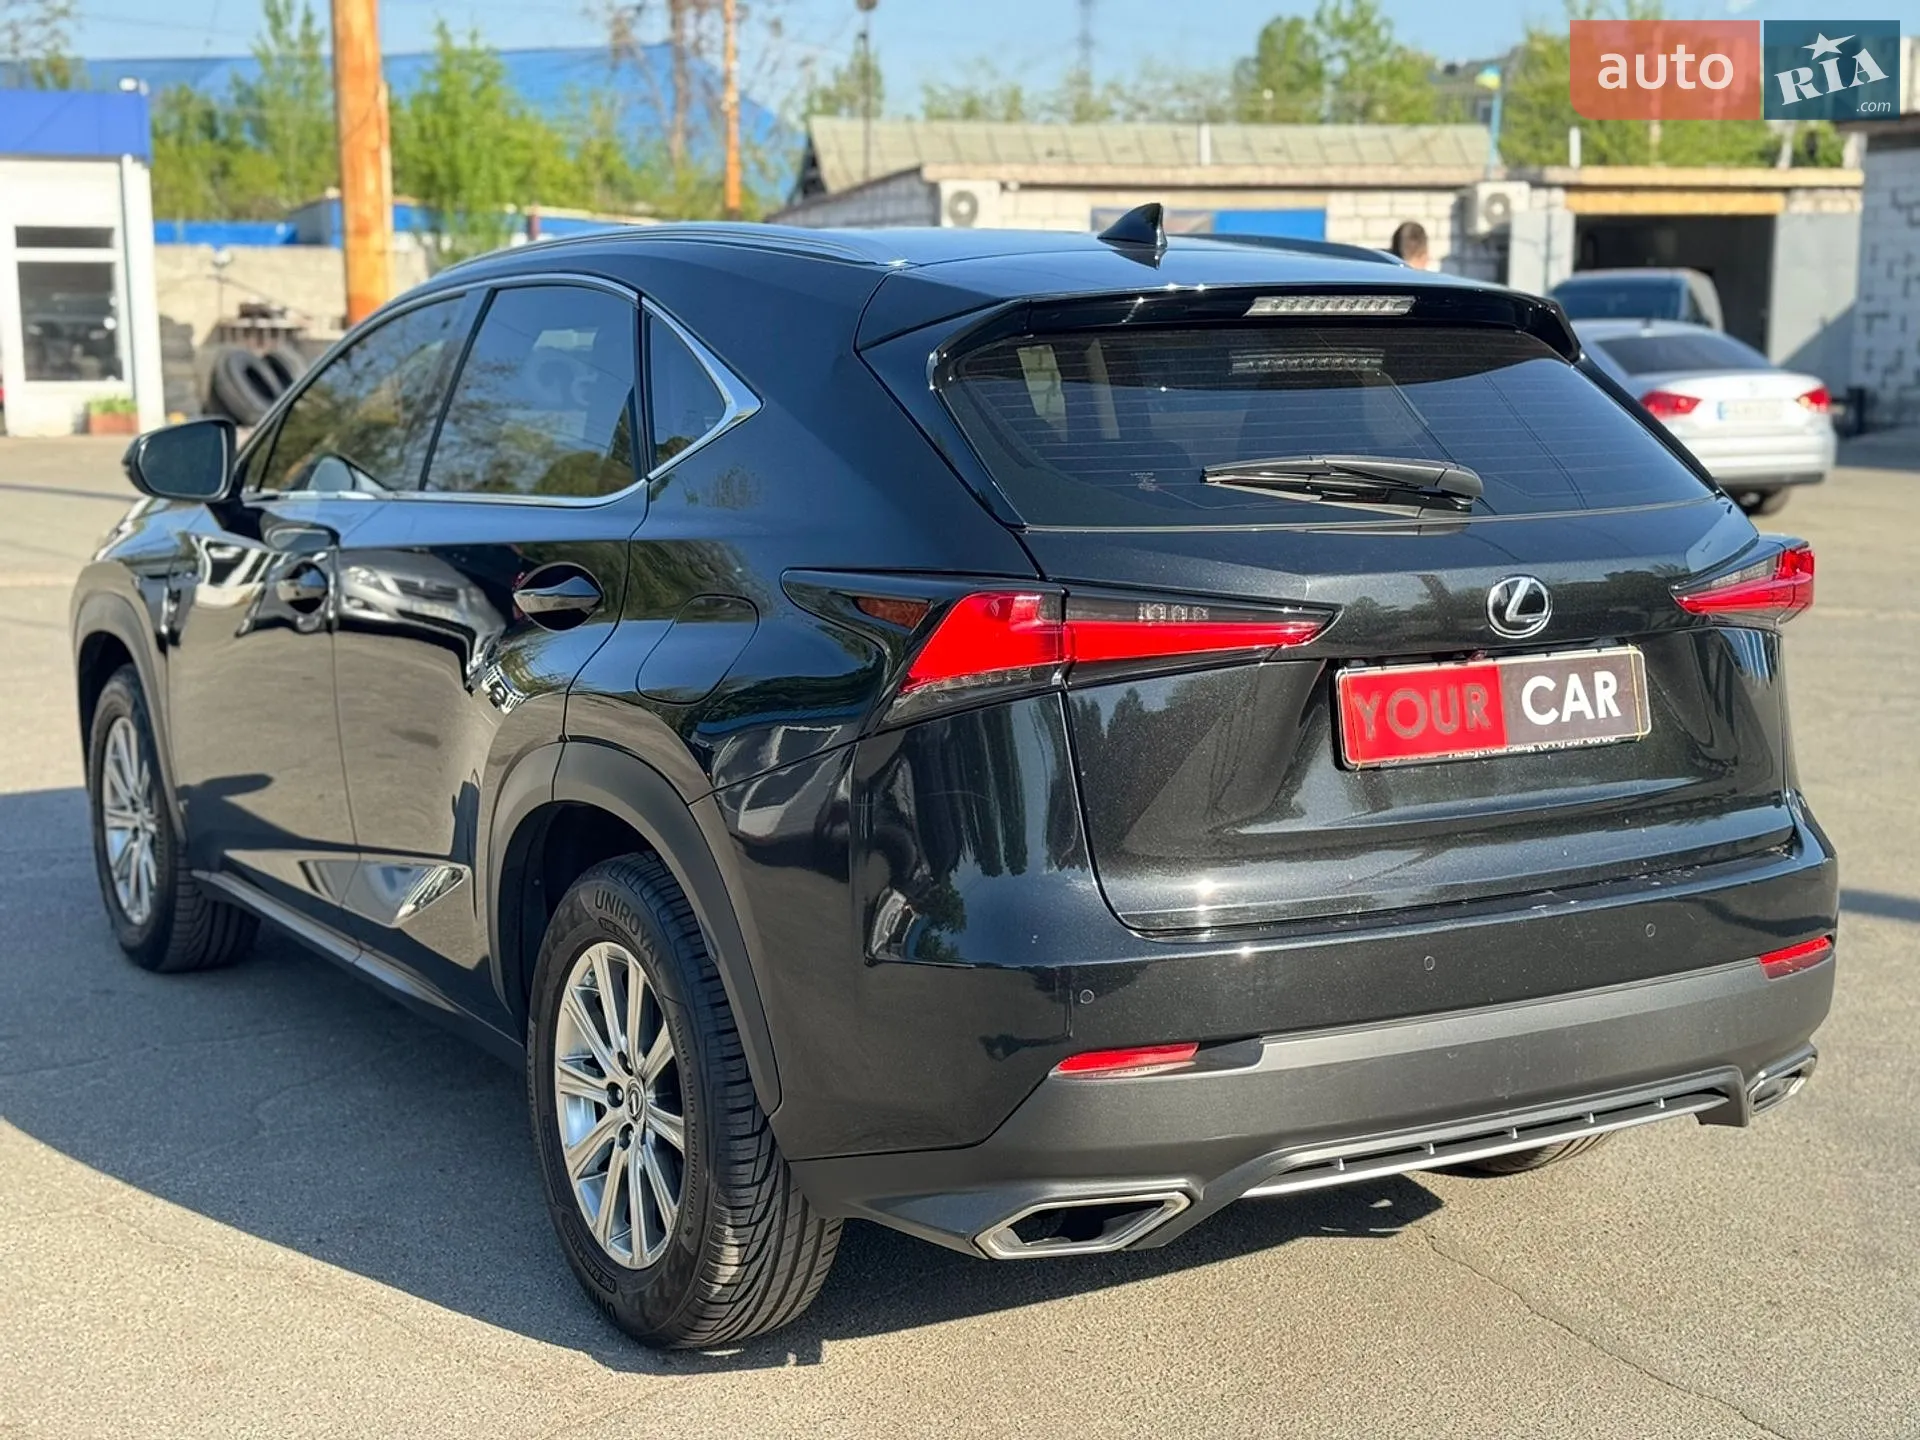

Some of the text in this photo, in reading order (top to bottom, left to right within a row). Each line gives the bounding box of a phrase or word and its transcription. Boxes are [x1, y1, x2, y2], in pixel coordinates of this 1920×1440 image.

[1355, 670, 1622, 741] YOUR CAR
[594, 889, 663, 980] UNIROYAL
